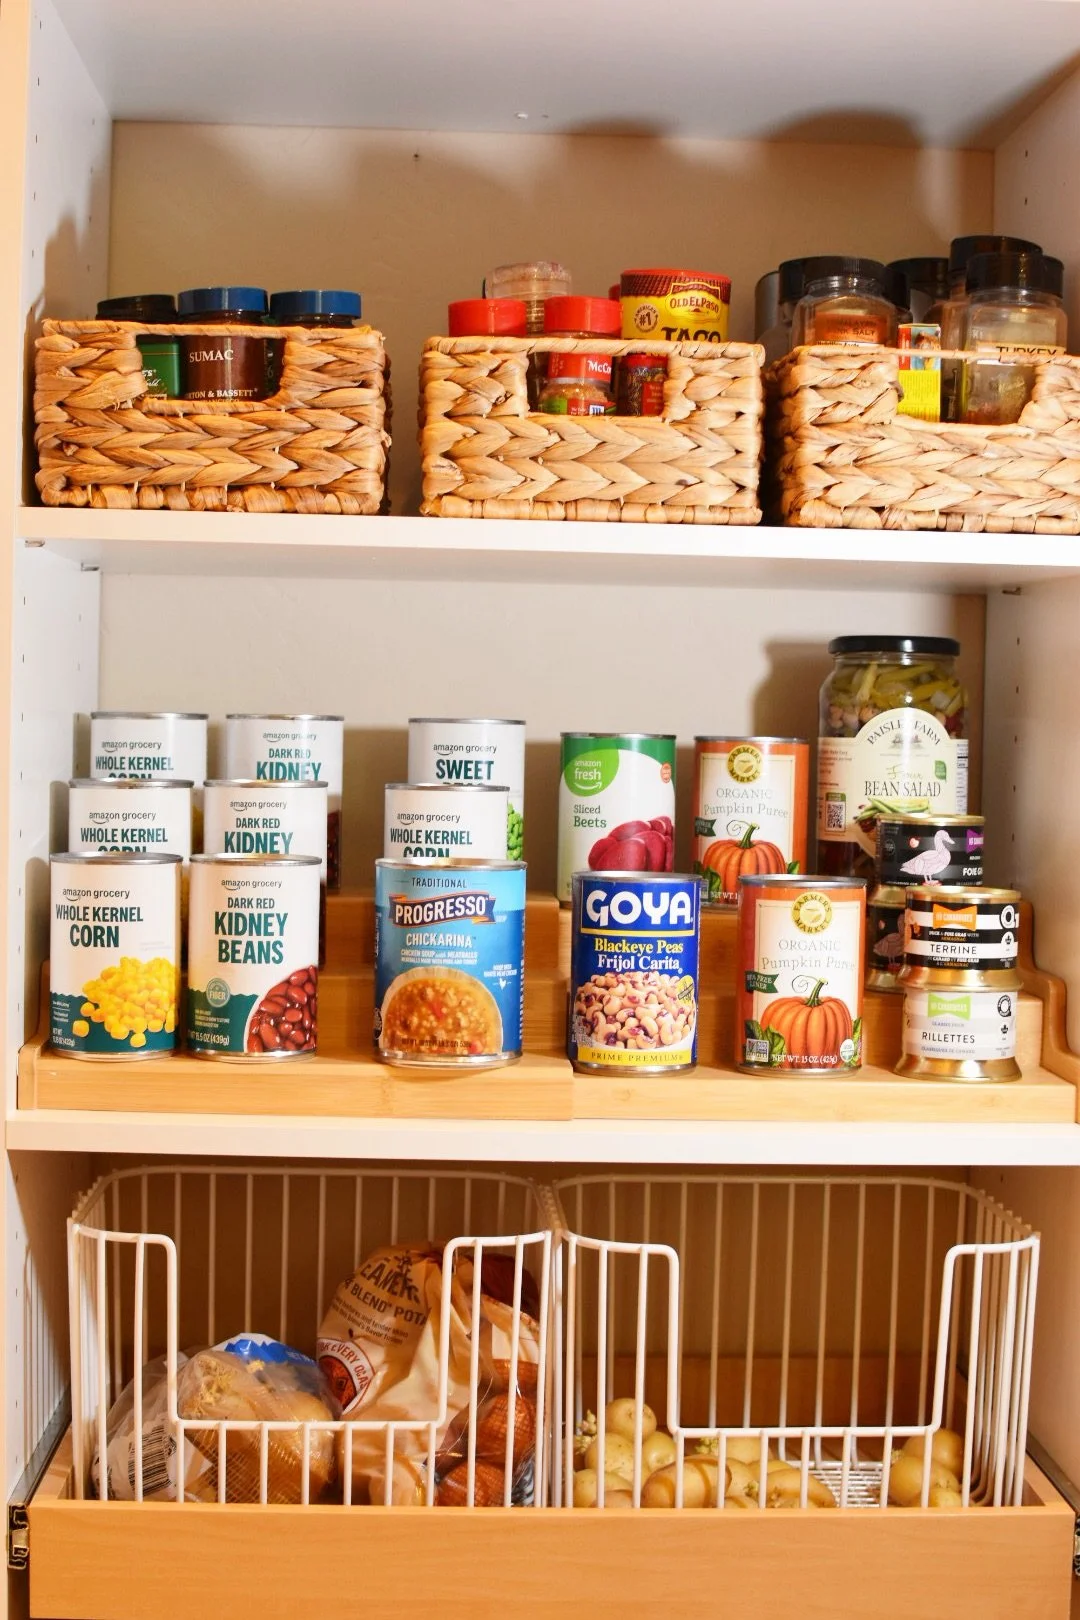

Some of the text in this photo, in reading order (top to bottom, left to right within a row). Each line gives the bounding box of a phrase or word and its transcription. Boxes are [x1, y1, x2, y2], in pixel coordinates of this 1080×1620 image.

[639, 312, 652, 326] #1
[852, 328, 875, 336] SALT
[189, 349, 234, 363] SUMAC
[207, 390, 215, 398] &
[216, 389, 254, 398] BASSETT
[262, 731, 290, 740] amazon
[866, 719, 941, 746] PAISLE FARM
[101, 741, 162, 750] amazon grocery
[433, 743, 464, 752] amazon
[268, 748, 293, 759] DARK
[95, 756, 174, 771] WHOLE KERNEL
[435, 758, 494, 780] SWEET
[256, 761, 322, 781] KIDNEY
[574, 768, 602, 780] fresh
[716, 787, 773, 800] ORGANIC
[864, 780, 941, 798] BEAN SALAD
[230, 800, 287, 810] amazon grocery
[573, 804, 601, 814] Sliced
[703, 802, 753, 816] Pumpkin
[88, 811, 157, 822] amazon grocery
[235, 817, 280, 829] DARK RED
[397, 813, 461, 824] amazon grocery
[573, 815, 607, 829] Beets
[80, 827, 169, 843] WHOLE KERNEL
[390, 827, 473, 845] WHOLE KERNEL
[224, 831, 293, 855] KIDNEY
[221, 879, 283, 889] amazon grocery
[411, 877, 468, 889] TRADITIONAL
[62, 888, 131, 900] amazon grocery
[227, 897, 275, 910] DARK RED
[395, 895, 488, 925] PROGRESSO
[585, 889, 692, 927] GOYA
[55, 903, 144, 923] WHOLE KERNEL
[214, 911, 289, 937] KIDNEY
[69, 923, 120, 948] CORN
[405, 932, 473, 949] CHICKARINA
[218, 939, 284, 965] BEANS
[593, 937, 684, 956] Blackeye Peas
[778, 939, 841, 952] ORGANIC
[930, 943, 977, 955] TERRINE
[597, 953, 680, 972] Frijol Carita
[761, 956, 821, 970] Pumpkin
[922, 1031, 976, 1044] RILLETTES
[591, 1051, 623, 1061] PRIME
[772, 1054, 786, 1063] NET
[801, 1055, 808, 1063] 15
[808, 1055, 819, 1064] OZ
[350, 1283, 388, 1313] BLEND
[331, 1343, 360, 1364] EVERY
